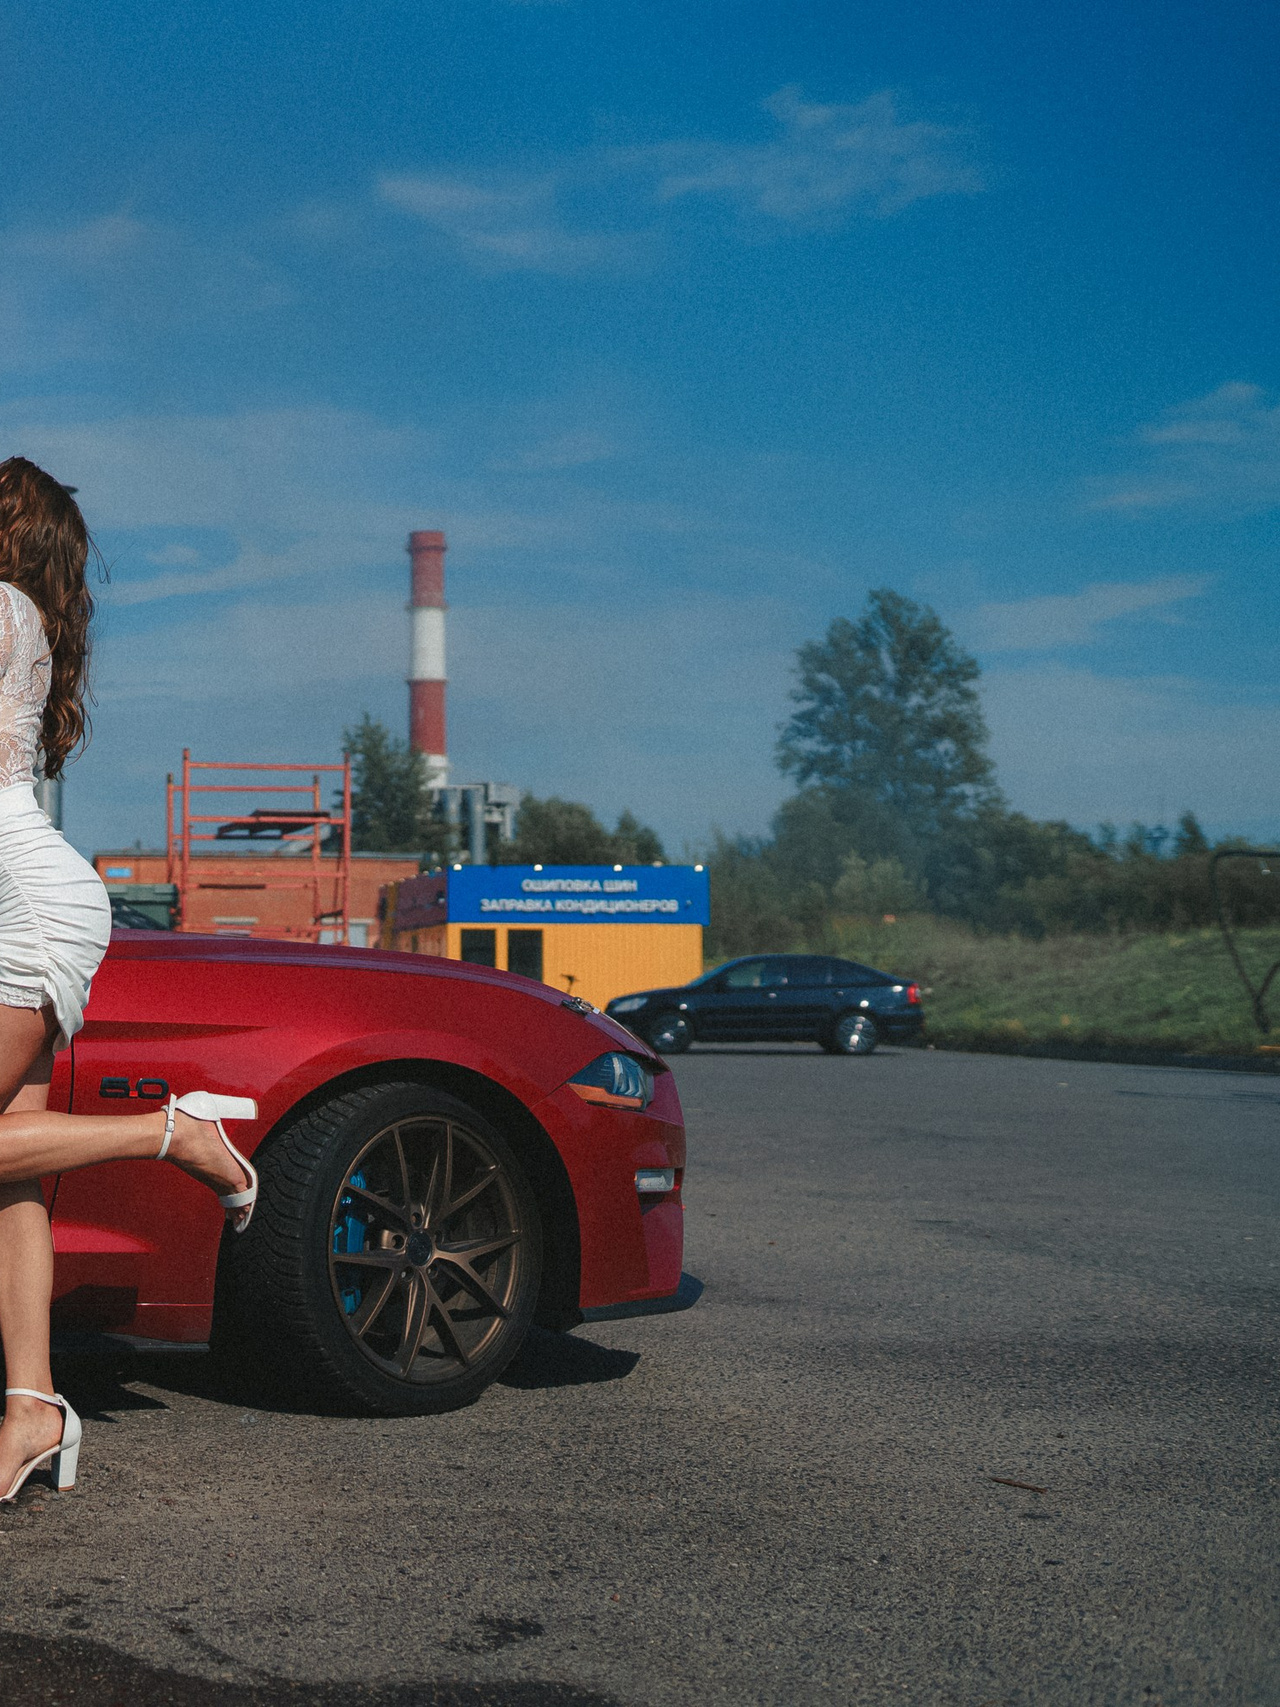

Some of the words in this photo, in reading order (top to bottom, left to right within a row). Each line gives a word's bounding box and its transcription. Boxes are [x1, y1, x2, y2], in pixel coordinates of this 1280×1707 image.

[604, 879, 637, 892] ШИН
[481, 898, 553, 912] ЗАПРАВКА
[556, 899, 679, 914] КОНДИЦИОНЕРОВ
[99, 1076, 170, 1100] 5.0
